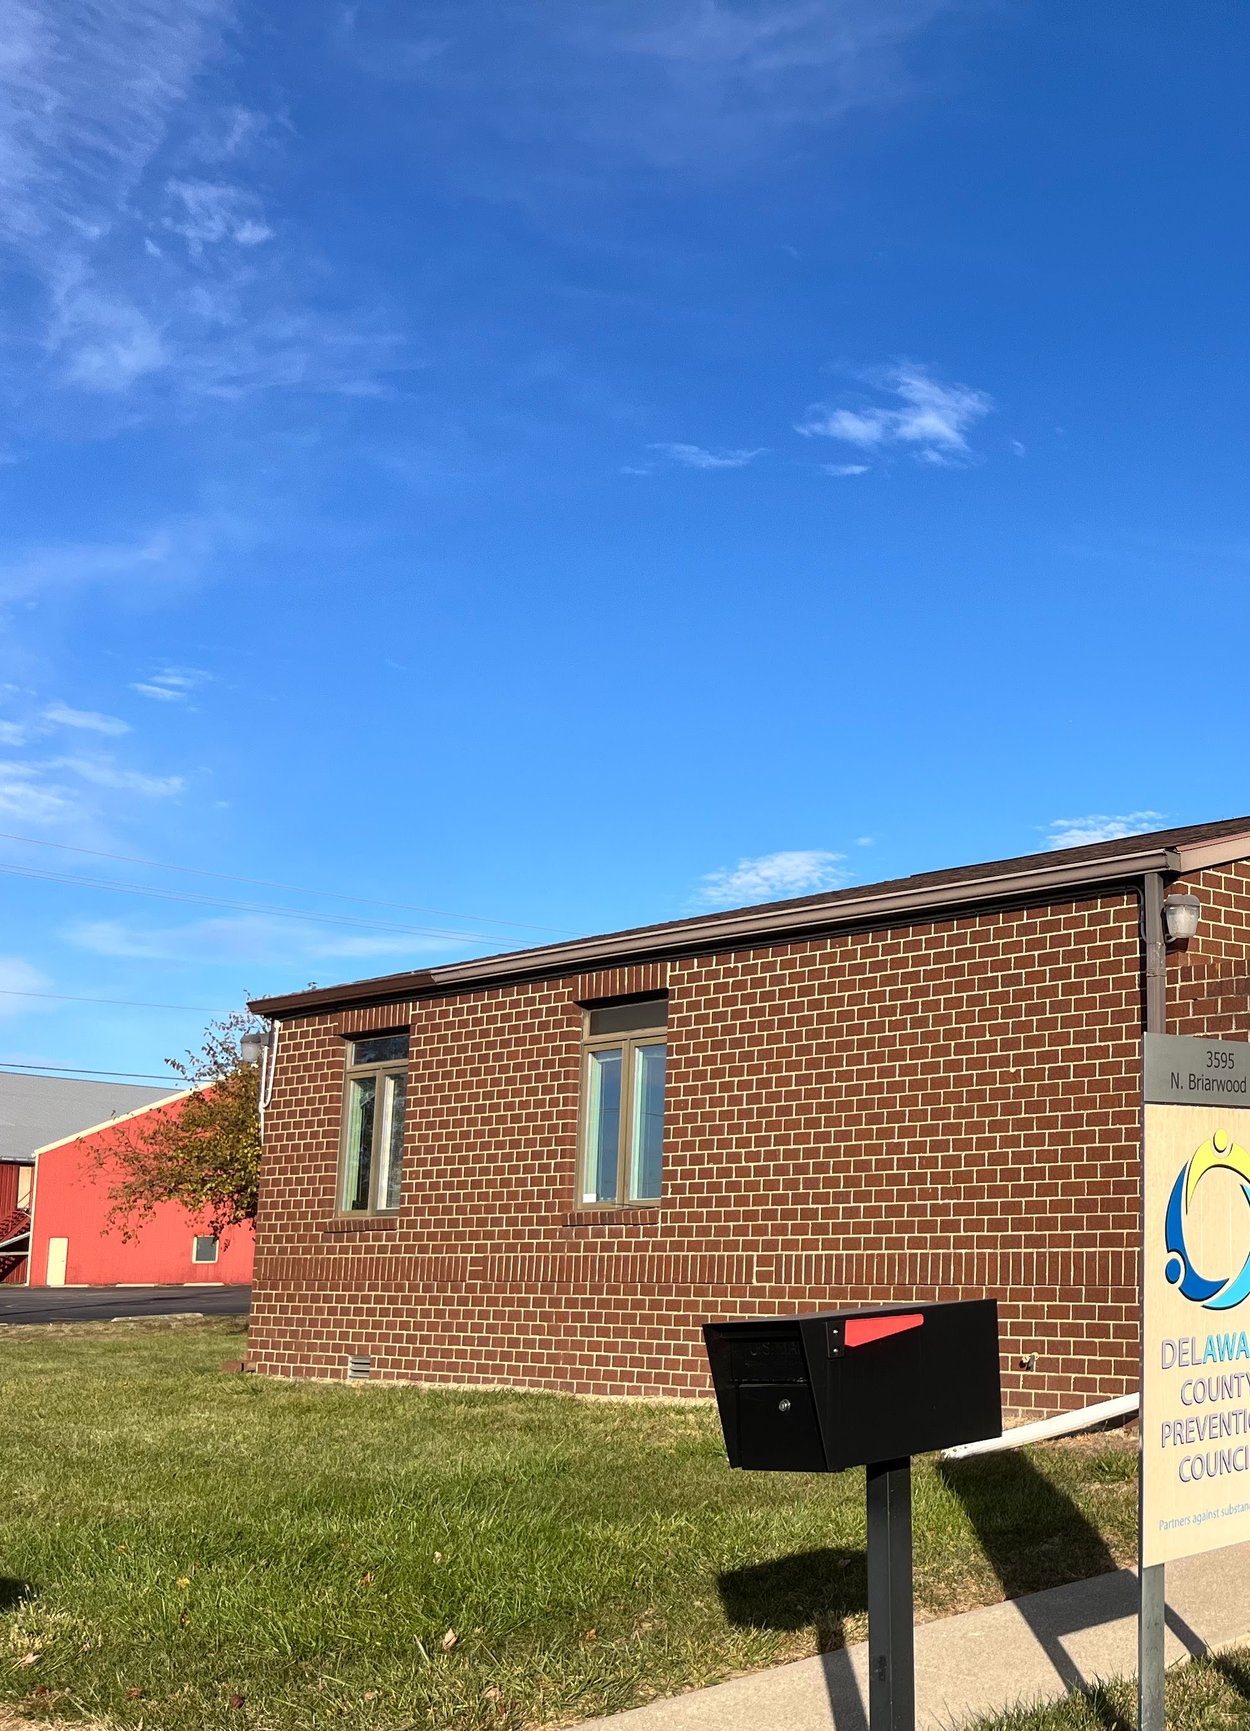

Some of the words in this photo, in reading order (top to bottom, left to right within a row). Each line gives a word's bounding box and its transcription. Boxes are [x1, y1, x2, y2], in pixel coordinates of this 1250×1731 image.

[1206, 1051, 1235, 1070] 3595
[1170, 1072, 1184, 1090] N.
[1188, 1073, 1247, 1094] Briarwood
[1159, 1514, 1191, 1531] Partners
[1192, 1508, 1220, 1528] against
